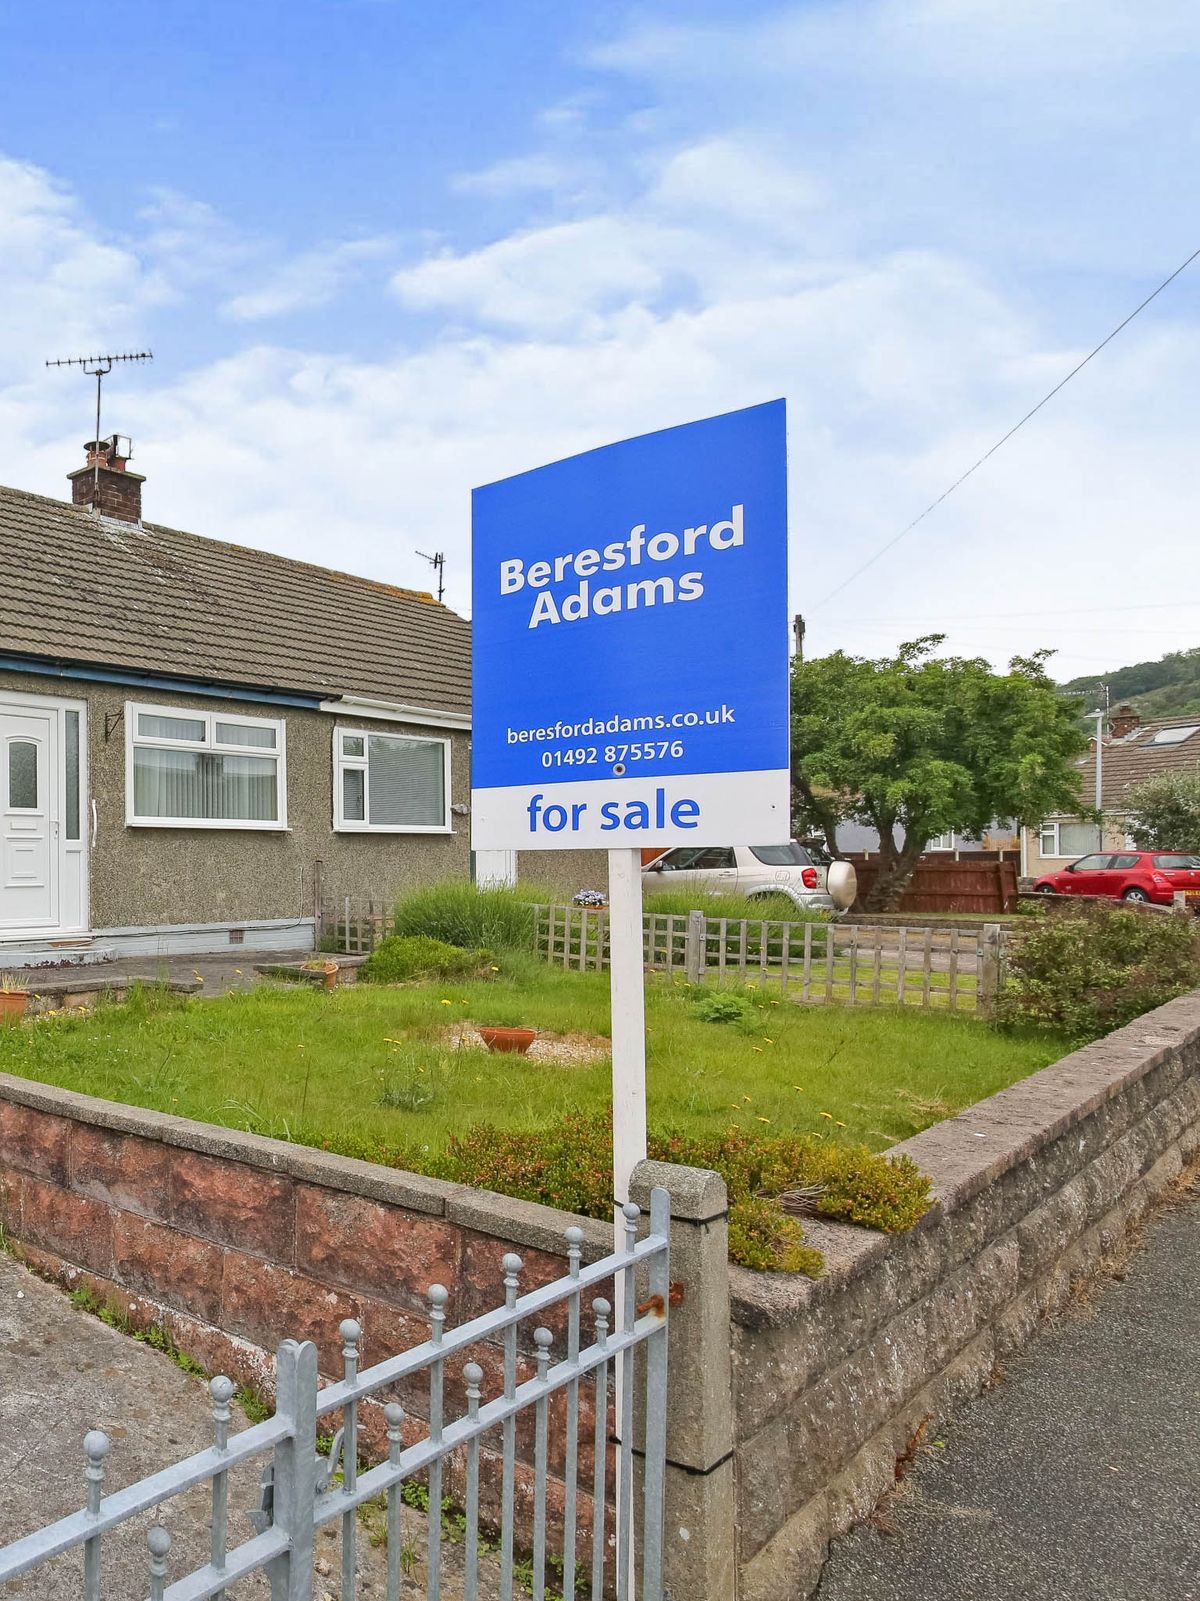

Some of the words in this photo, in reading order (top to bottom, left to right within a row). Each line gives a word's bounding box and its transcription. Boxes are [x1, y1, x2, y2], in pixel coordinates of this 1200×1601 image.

[500, 503, 745, 596] Beresford
[528, 571, 705, 629] Adams
[507, 704, 736, 744] beresfordadams.co.uk
[541, 748, 598, 768] 01492
[604, 740, 684, 763] 875576
[526, 793, 588, 833] for
[600, 787, 701, 831] sale
